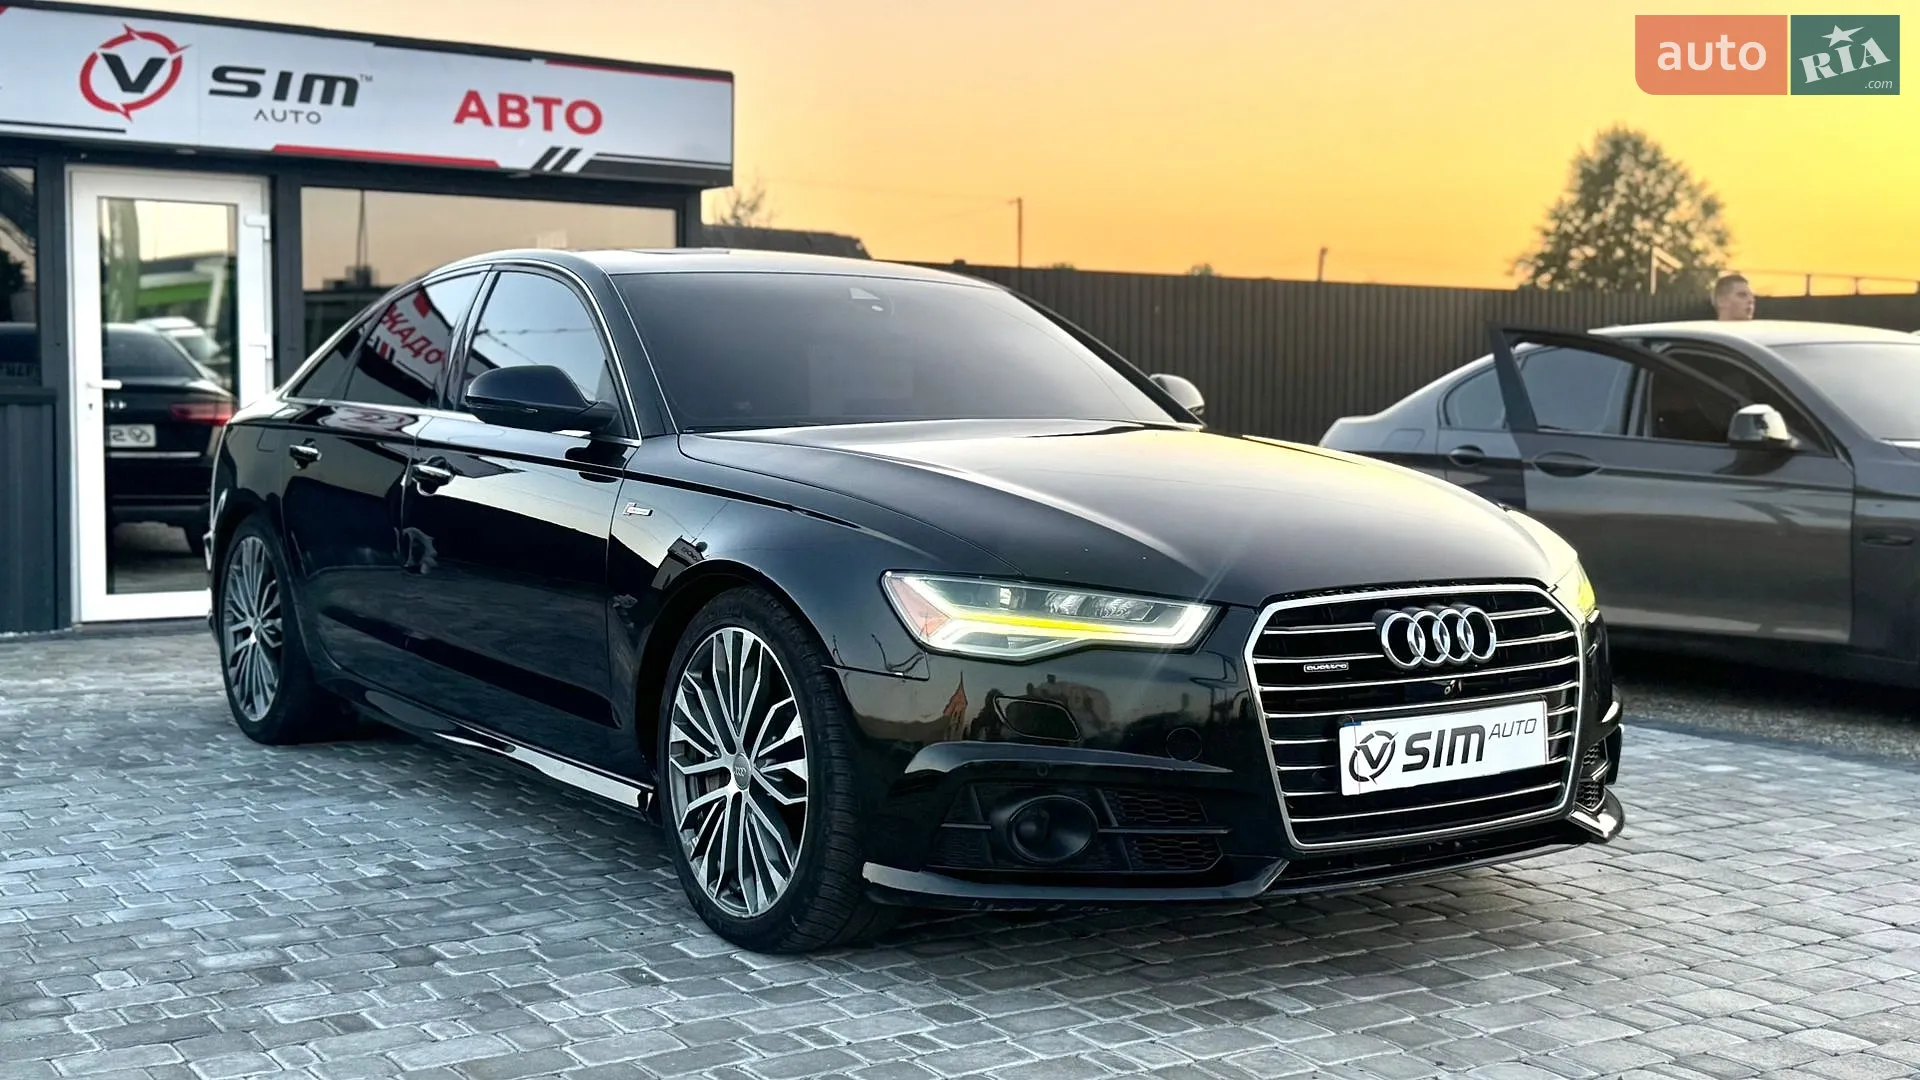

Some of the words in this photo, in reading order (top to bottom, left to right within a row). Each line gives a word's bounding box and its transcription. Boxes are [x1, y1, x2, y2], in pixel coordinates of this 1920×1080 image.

[208, 65, 360, 107] SIM
[254, 108, 322, 124] AUTO
[453, 89, 604, 136] АВТО
[1402, 724, 1486, 773] SIM
[1488, 718, 1538, 740] AUTO
